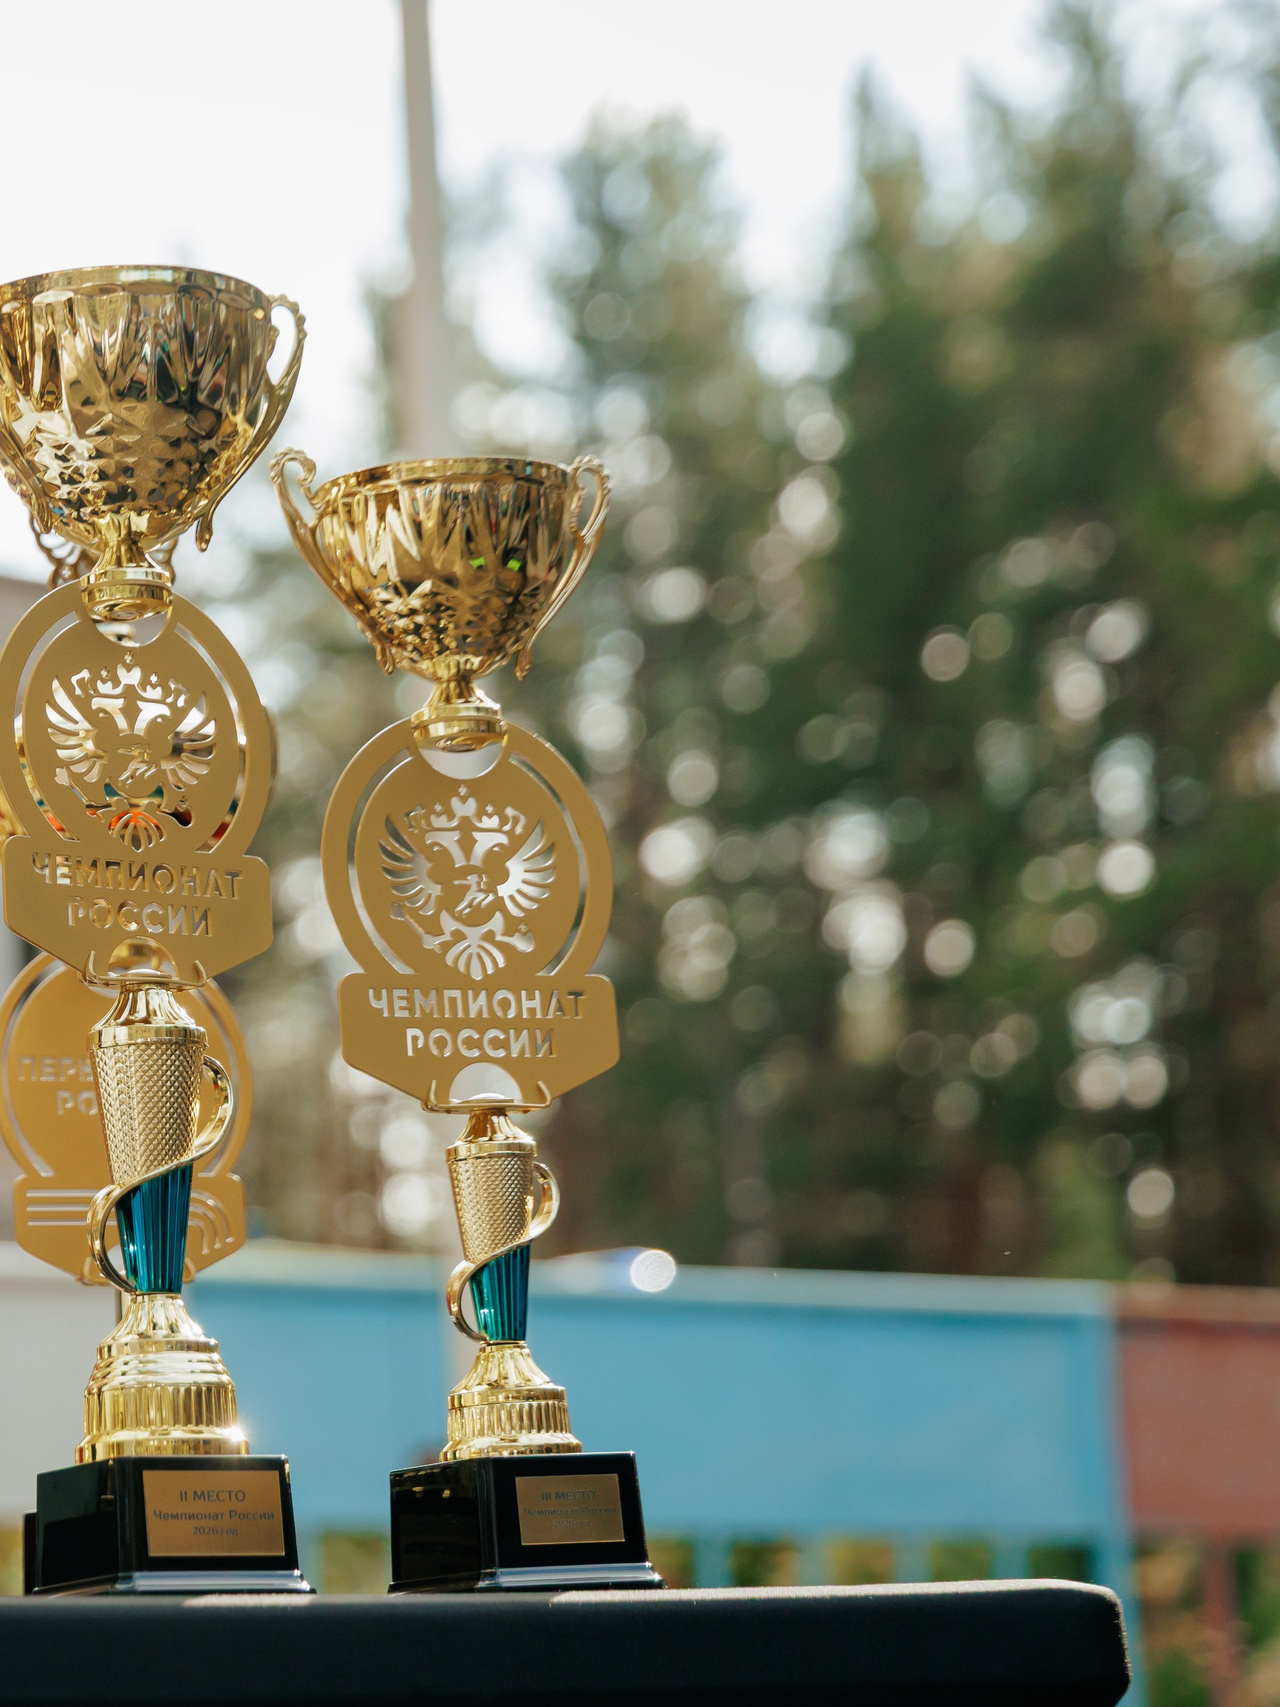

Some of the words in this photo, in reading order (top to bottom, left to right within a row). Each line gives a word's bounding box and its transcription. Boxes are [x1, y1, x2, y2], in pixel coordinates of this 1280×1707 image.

[31, 851, 243, 900] ЧЕМПИОНАТ
[66, 895, 213, 937] РОССИИ
[368, 987, 587, 1019] ЧЕМПИОНАТ
[405, 1027, 557, 1058] РОССИИ
[179, 1490, 188, 1502] II
[193, 1489, 246, 1503] МЕСТО
[555, 1490, 596, 1501] МЕСТО
[153, 1509, 225, 1521] Чемпионат
[228, 1509, 275, 1521] России
